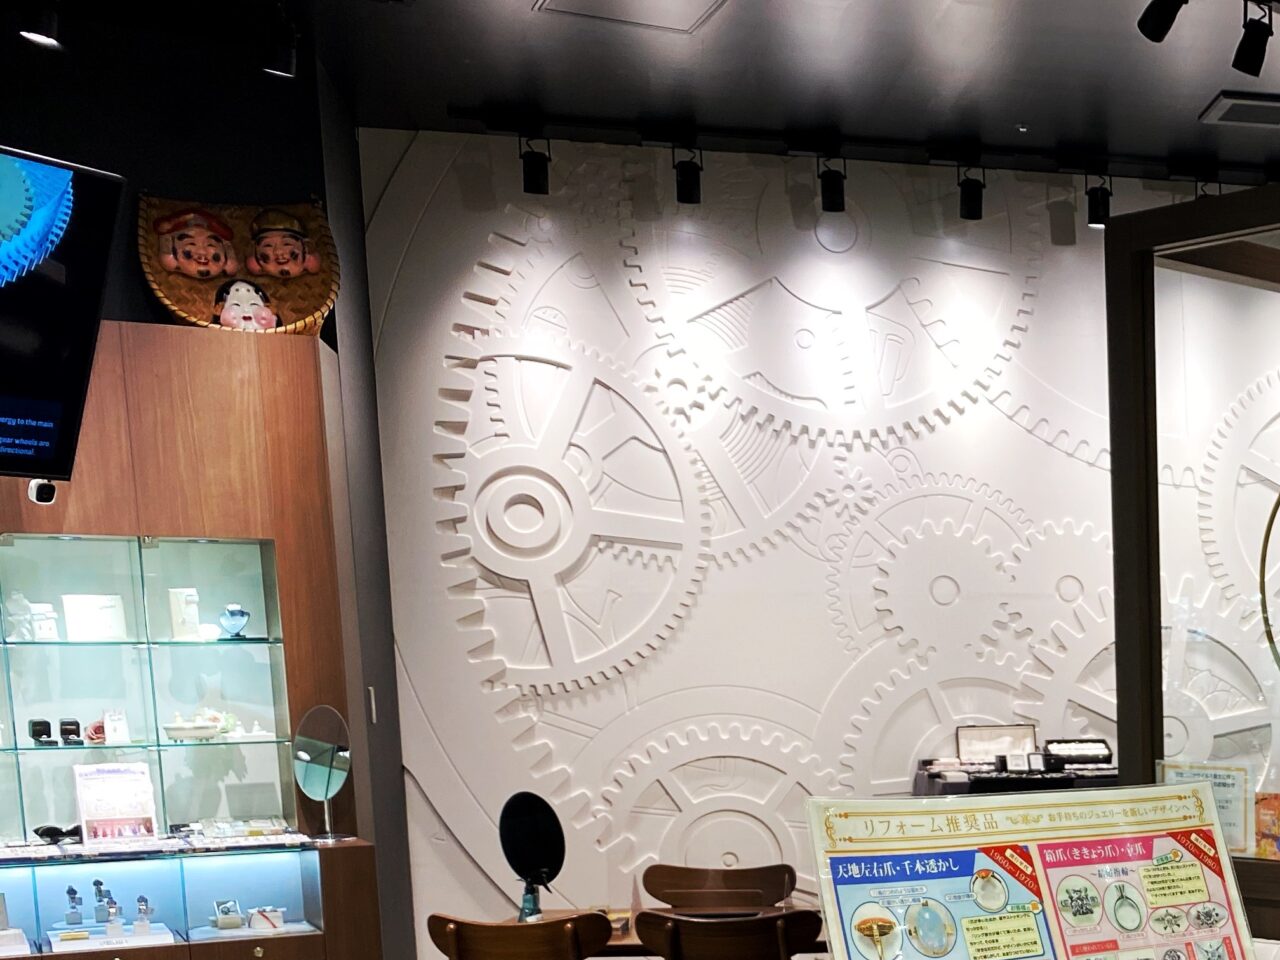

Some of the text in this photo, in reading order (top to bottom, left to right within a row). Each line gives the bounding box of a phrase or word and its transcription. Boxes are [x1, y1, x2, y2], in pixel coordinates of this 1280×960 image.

[865, 812, 1000, 835] リフォーム推奨品
